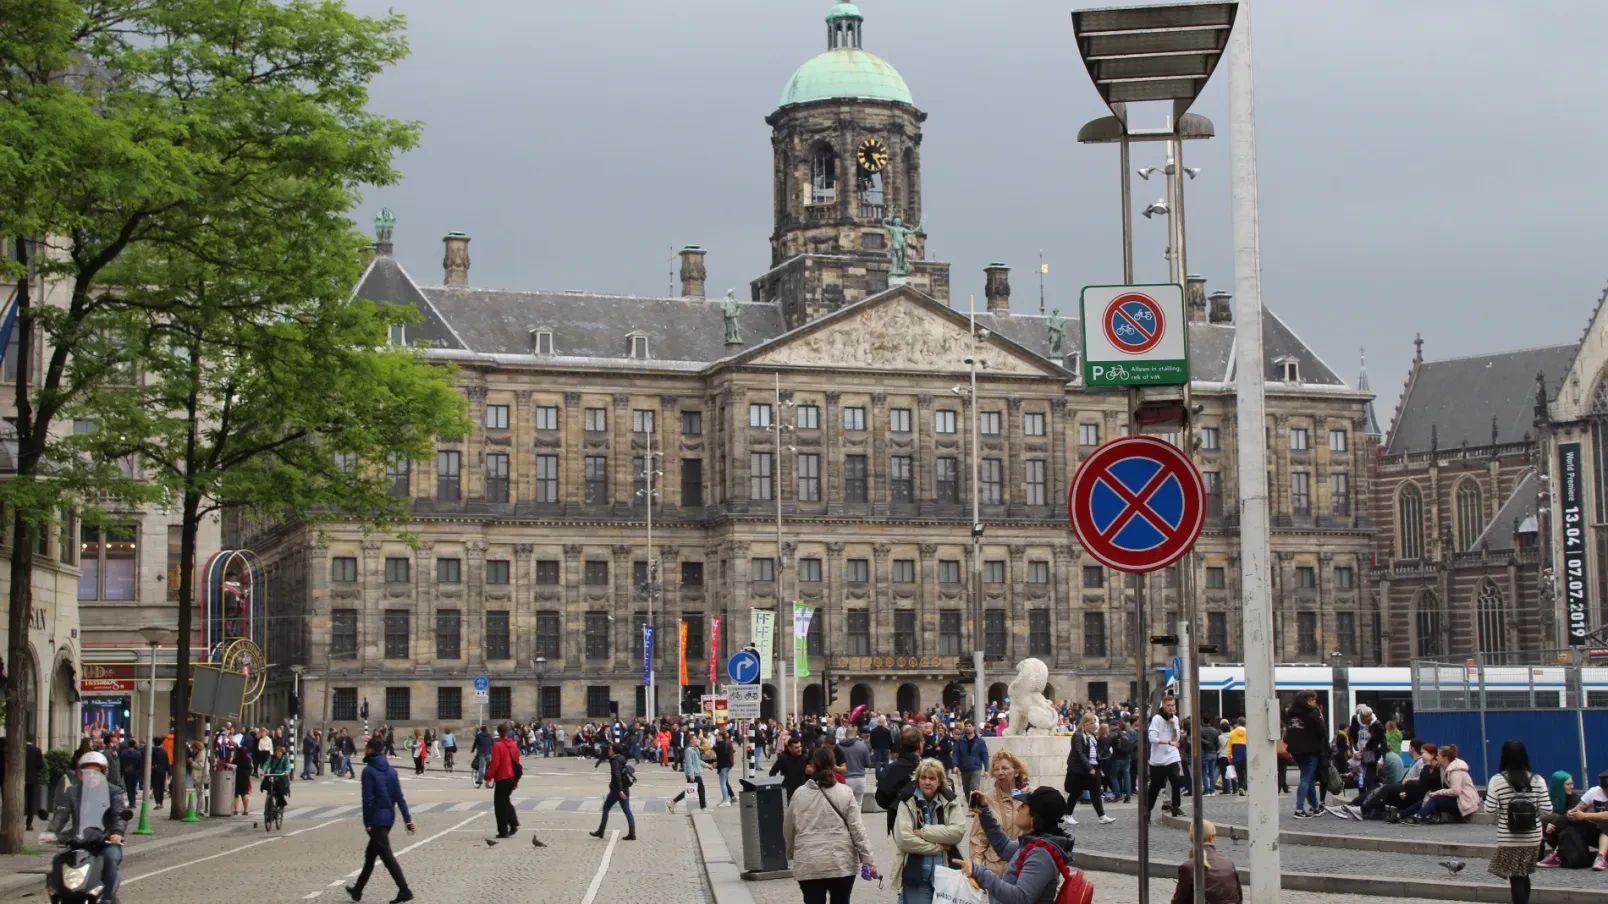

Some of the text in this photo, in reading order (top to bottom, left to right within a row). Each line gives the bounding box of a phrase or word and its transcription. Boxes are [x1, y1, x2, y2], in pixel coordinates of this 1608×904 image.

[1092, 366, 1104, 380] P
[1565, 451, 1575, 471] World
[1567, 472, 1576, 502] Premiere
[1564, 506, 1580, 546] 13.04
[1567, 559, 1586, 638] 07.07.2019
